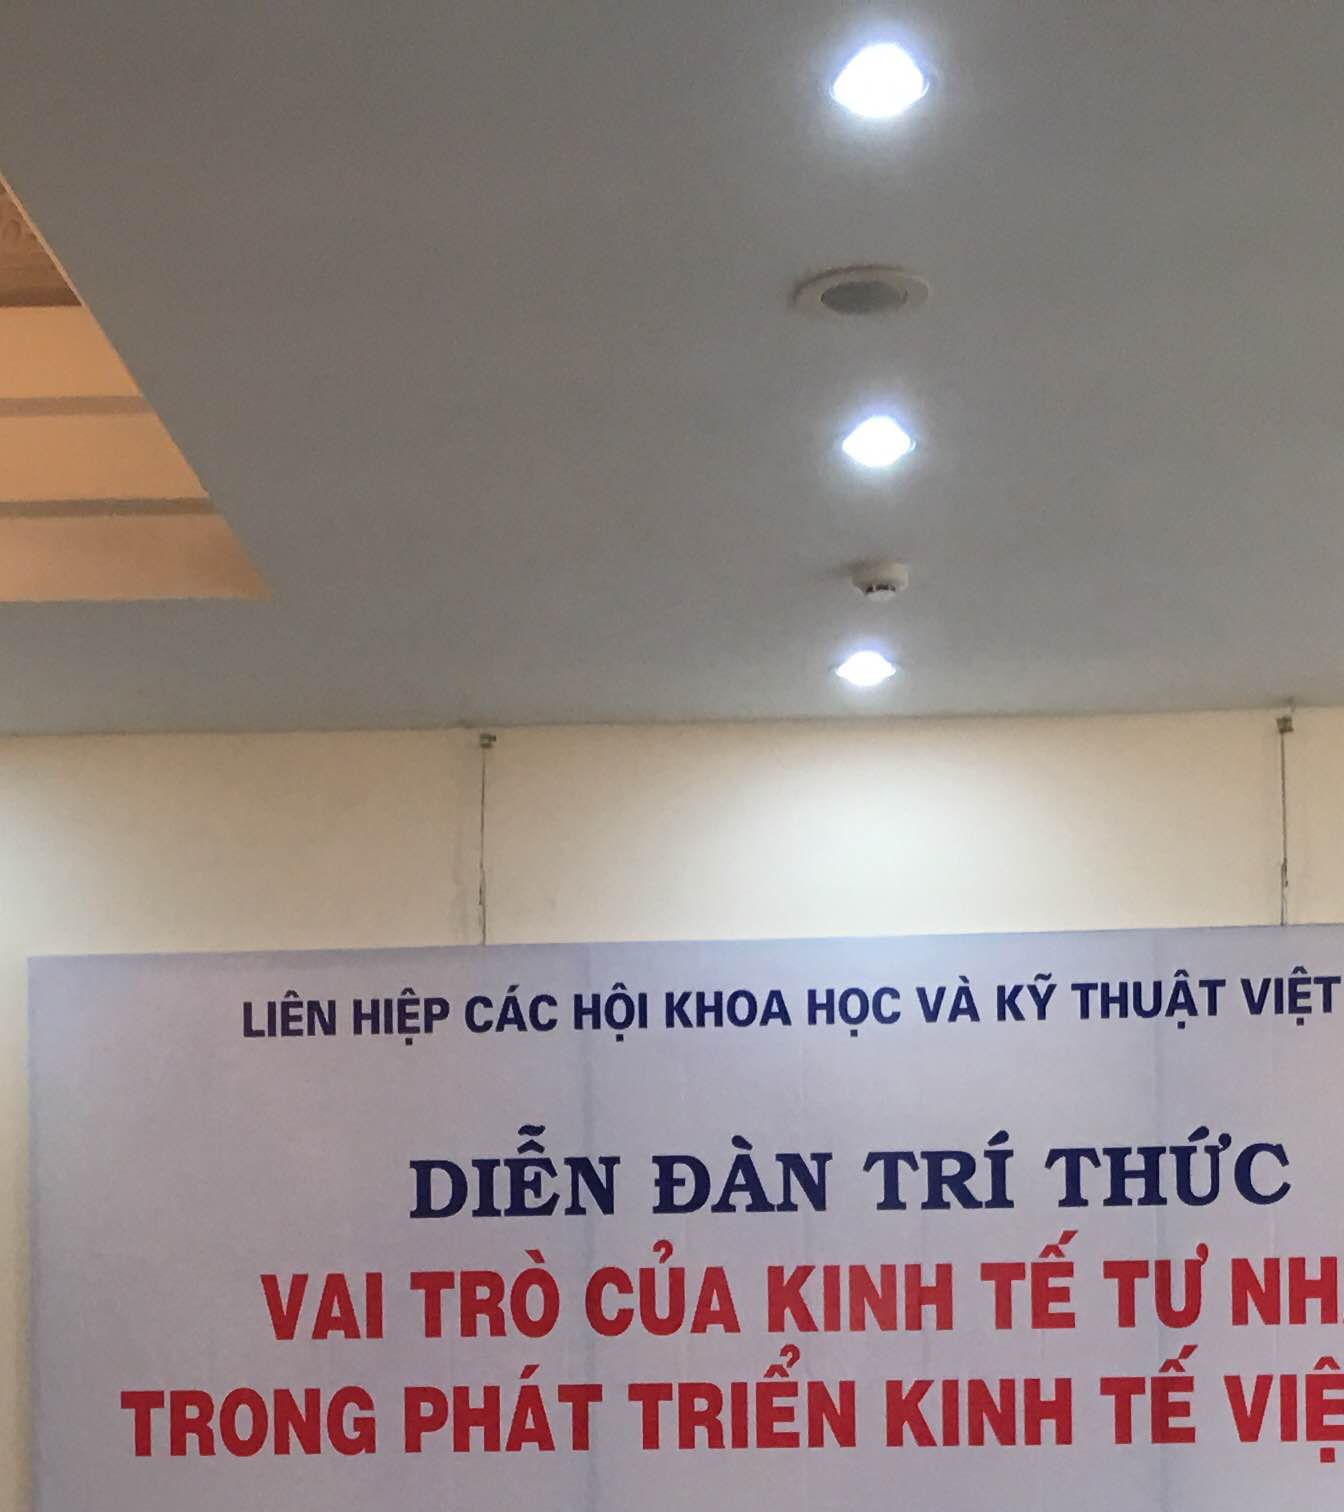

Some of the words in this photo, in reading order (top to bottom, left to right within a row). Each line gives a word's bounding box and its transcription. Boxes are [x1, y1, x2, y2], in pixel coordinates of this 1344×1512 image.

[243, 990, 336, 1037] LIÊN
[353, 988, 449, 1046] HIỆP
[465, 985, 557, 1033] CÁC
[574, 982, 647, 1042] HỘI
[666, 990, 792, 1028] KHOA
[808, 987, 900, 1037] HỌC
[916, 976, 980, 1023] VÀ
[997, 973, 1057, 1021] KỸ
[1071, 969, 1226, 1029] THUẬT
[1241, 966, 1341, 1026] VIỆT
[410, 1125, 620, 1218] DIỄN
[652, 1135, 832, 1214] ĐÀN
[863, 1130, 1014, 1210] TRÍ
[1045, 1126, 1291, 1207] THỨC
[260, 1272, 383, 1340] VAI
[410, 1249, 560, 1338] TRÒ
[585, 1240, 740, 1336] CỦA
[768, 1263, 953, 1332] KINH
[981, 1230, 1078, 1329] TẾ
[1103, 1243, 1208, 1328] TƯ
[121, 1386, 376, 1457] TRONG
[404, 1364, 602, 1453] PHÁT
[628, 1345, 856, 1450] TRIỂN
[886, 1378, 1072, 1447] KINH
[1100, 1344, 1198, 1444] TẾ
